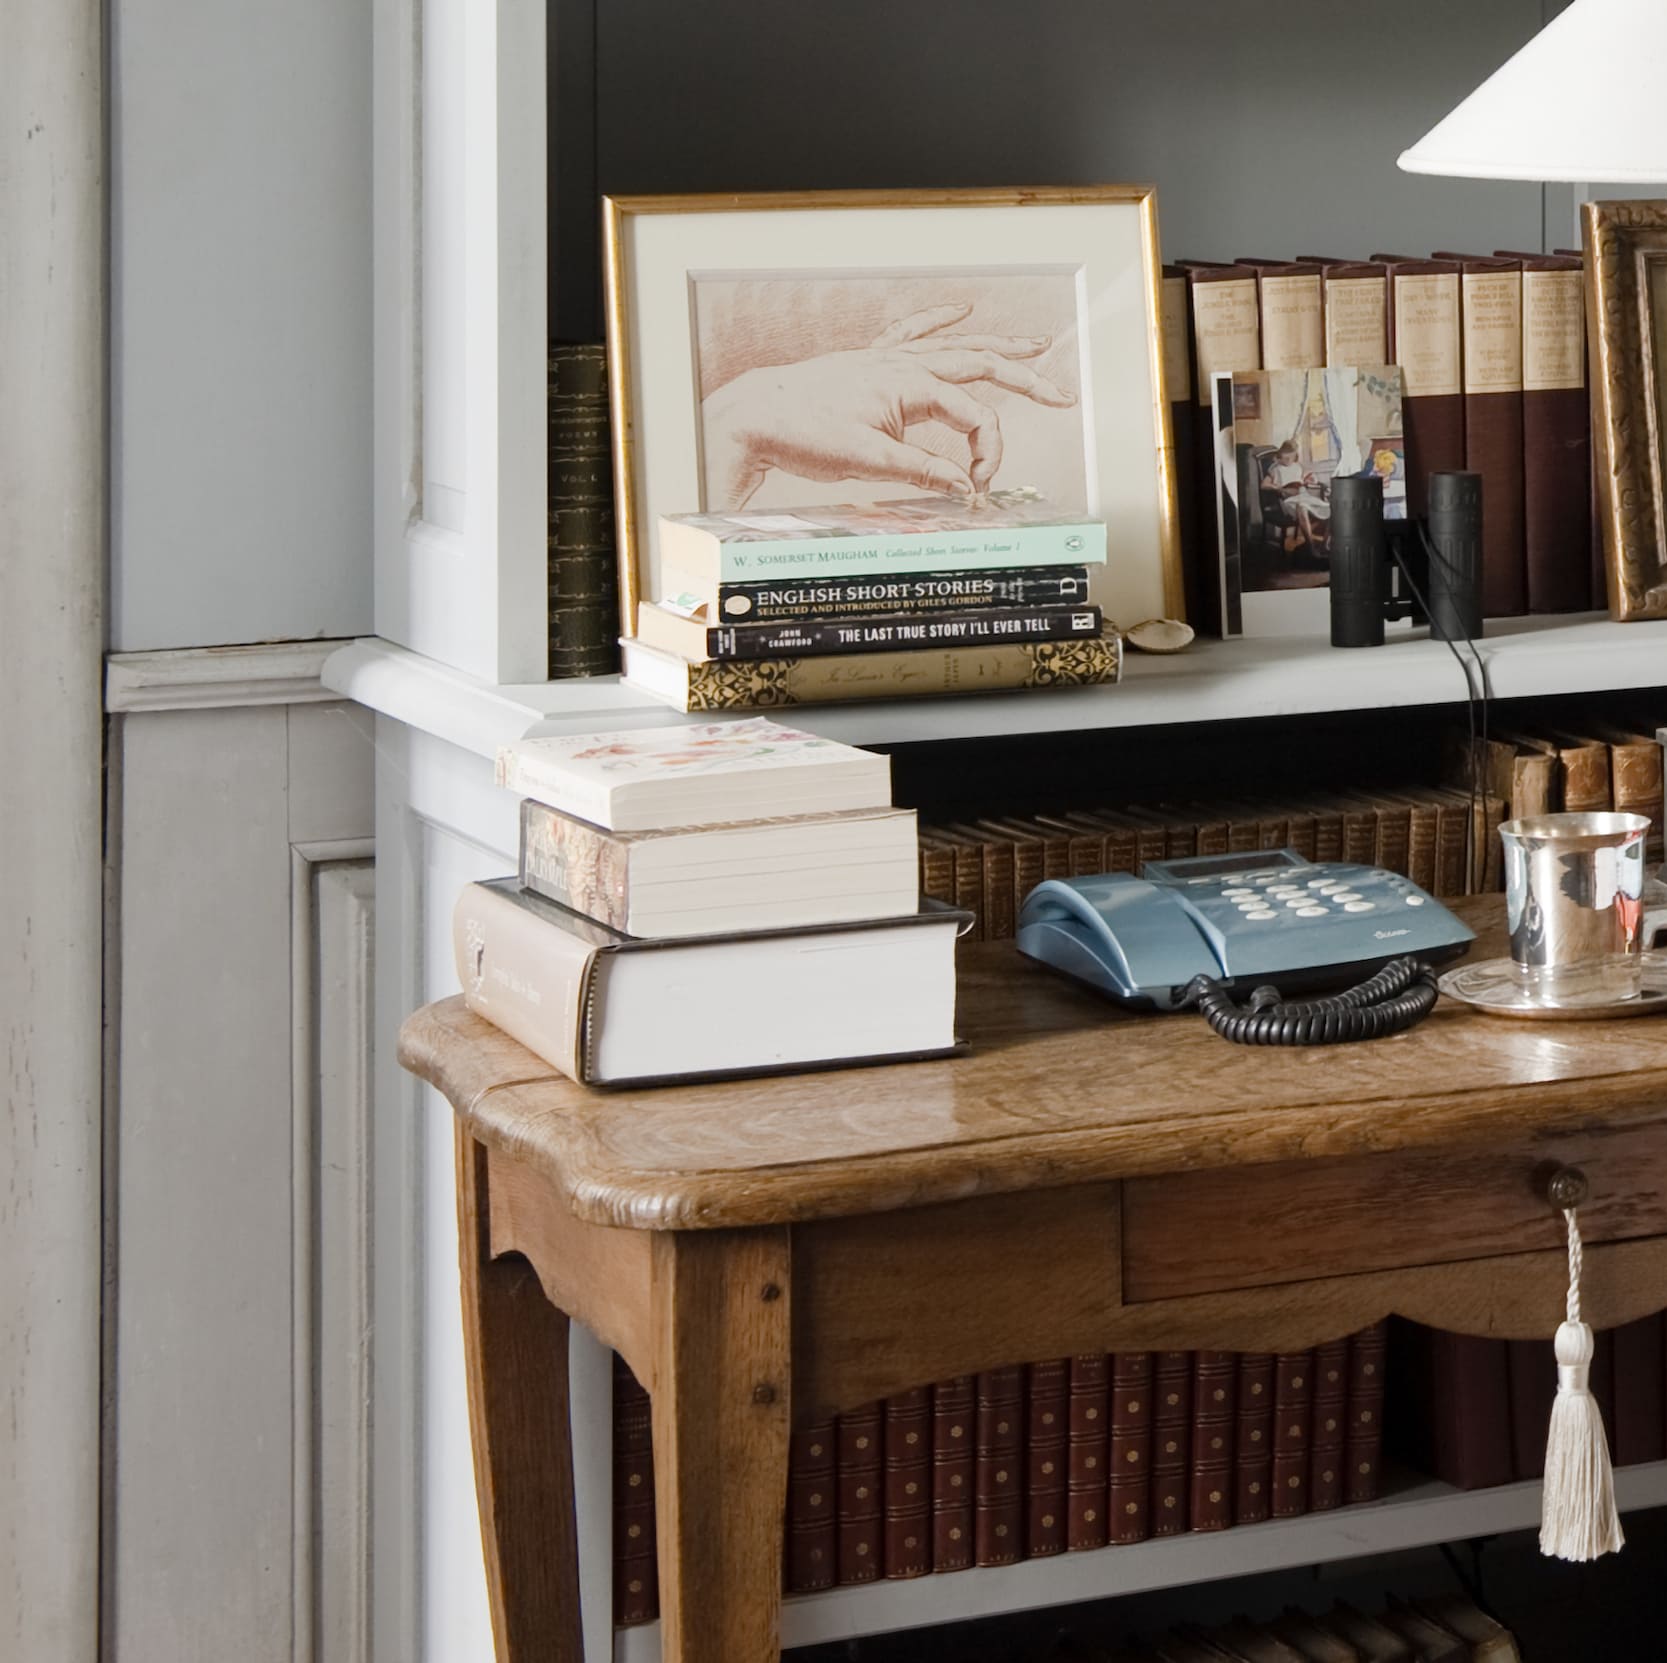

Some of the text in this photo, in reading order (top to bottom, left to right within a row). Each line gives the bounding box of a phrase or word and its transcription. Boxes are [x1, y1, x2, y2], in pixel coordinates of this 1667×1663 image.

[733, 557, 753, 567] W.
[757, 554, 815, 566] SOMERSET
[817, 550, 878, 562] MAUGHAM
[983, 543, 1012, 553] Volume
[757, 588, 841, 606] ENGLISH
[846, 584, 911, 600] SHORT
[914, 579, 994, 596] STORIES
[757, 595, 993, 616] SELECTED AND INTRODUCED BY GILES GORDON
[838, 618, 1051, 643] THE LAST TRUE STORY I'LL EVER TELL
